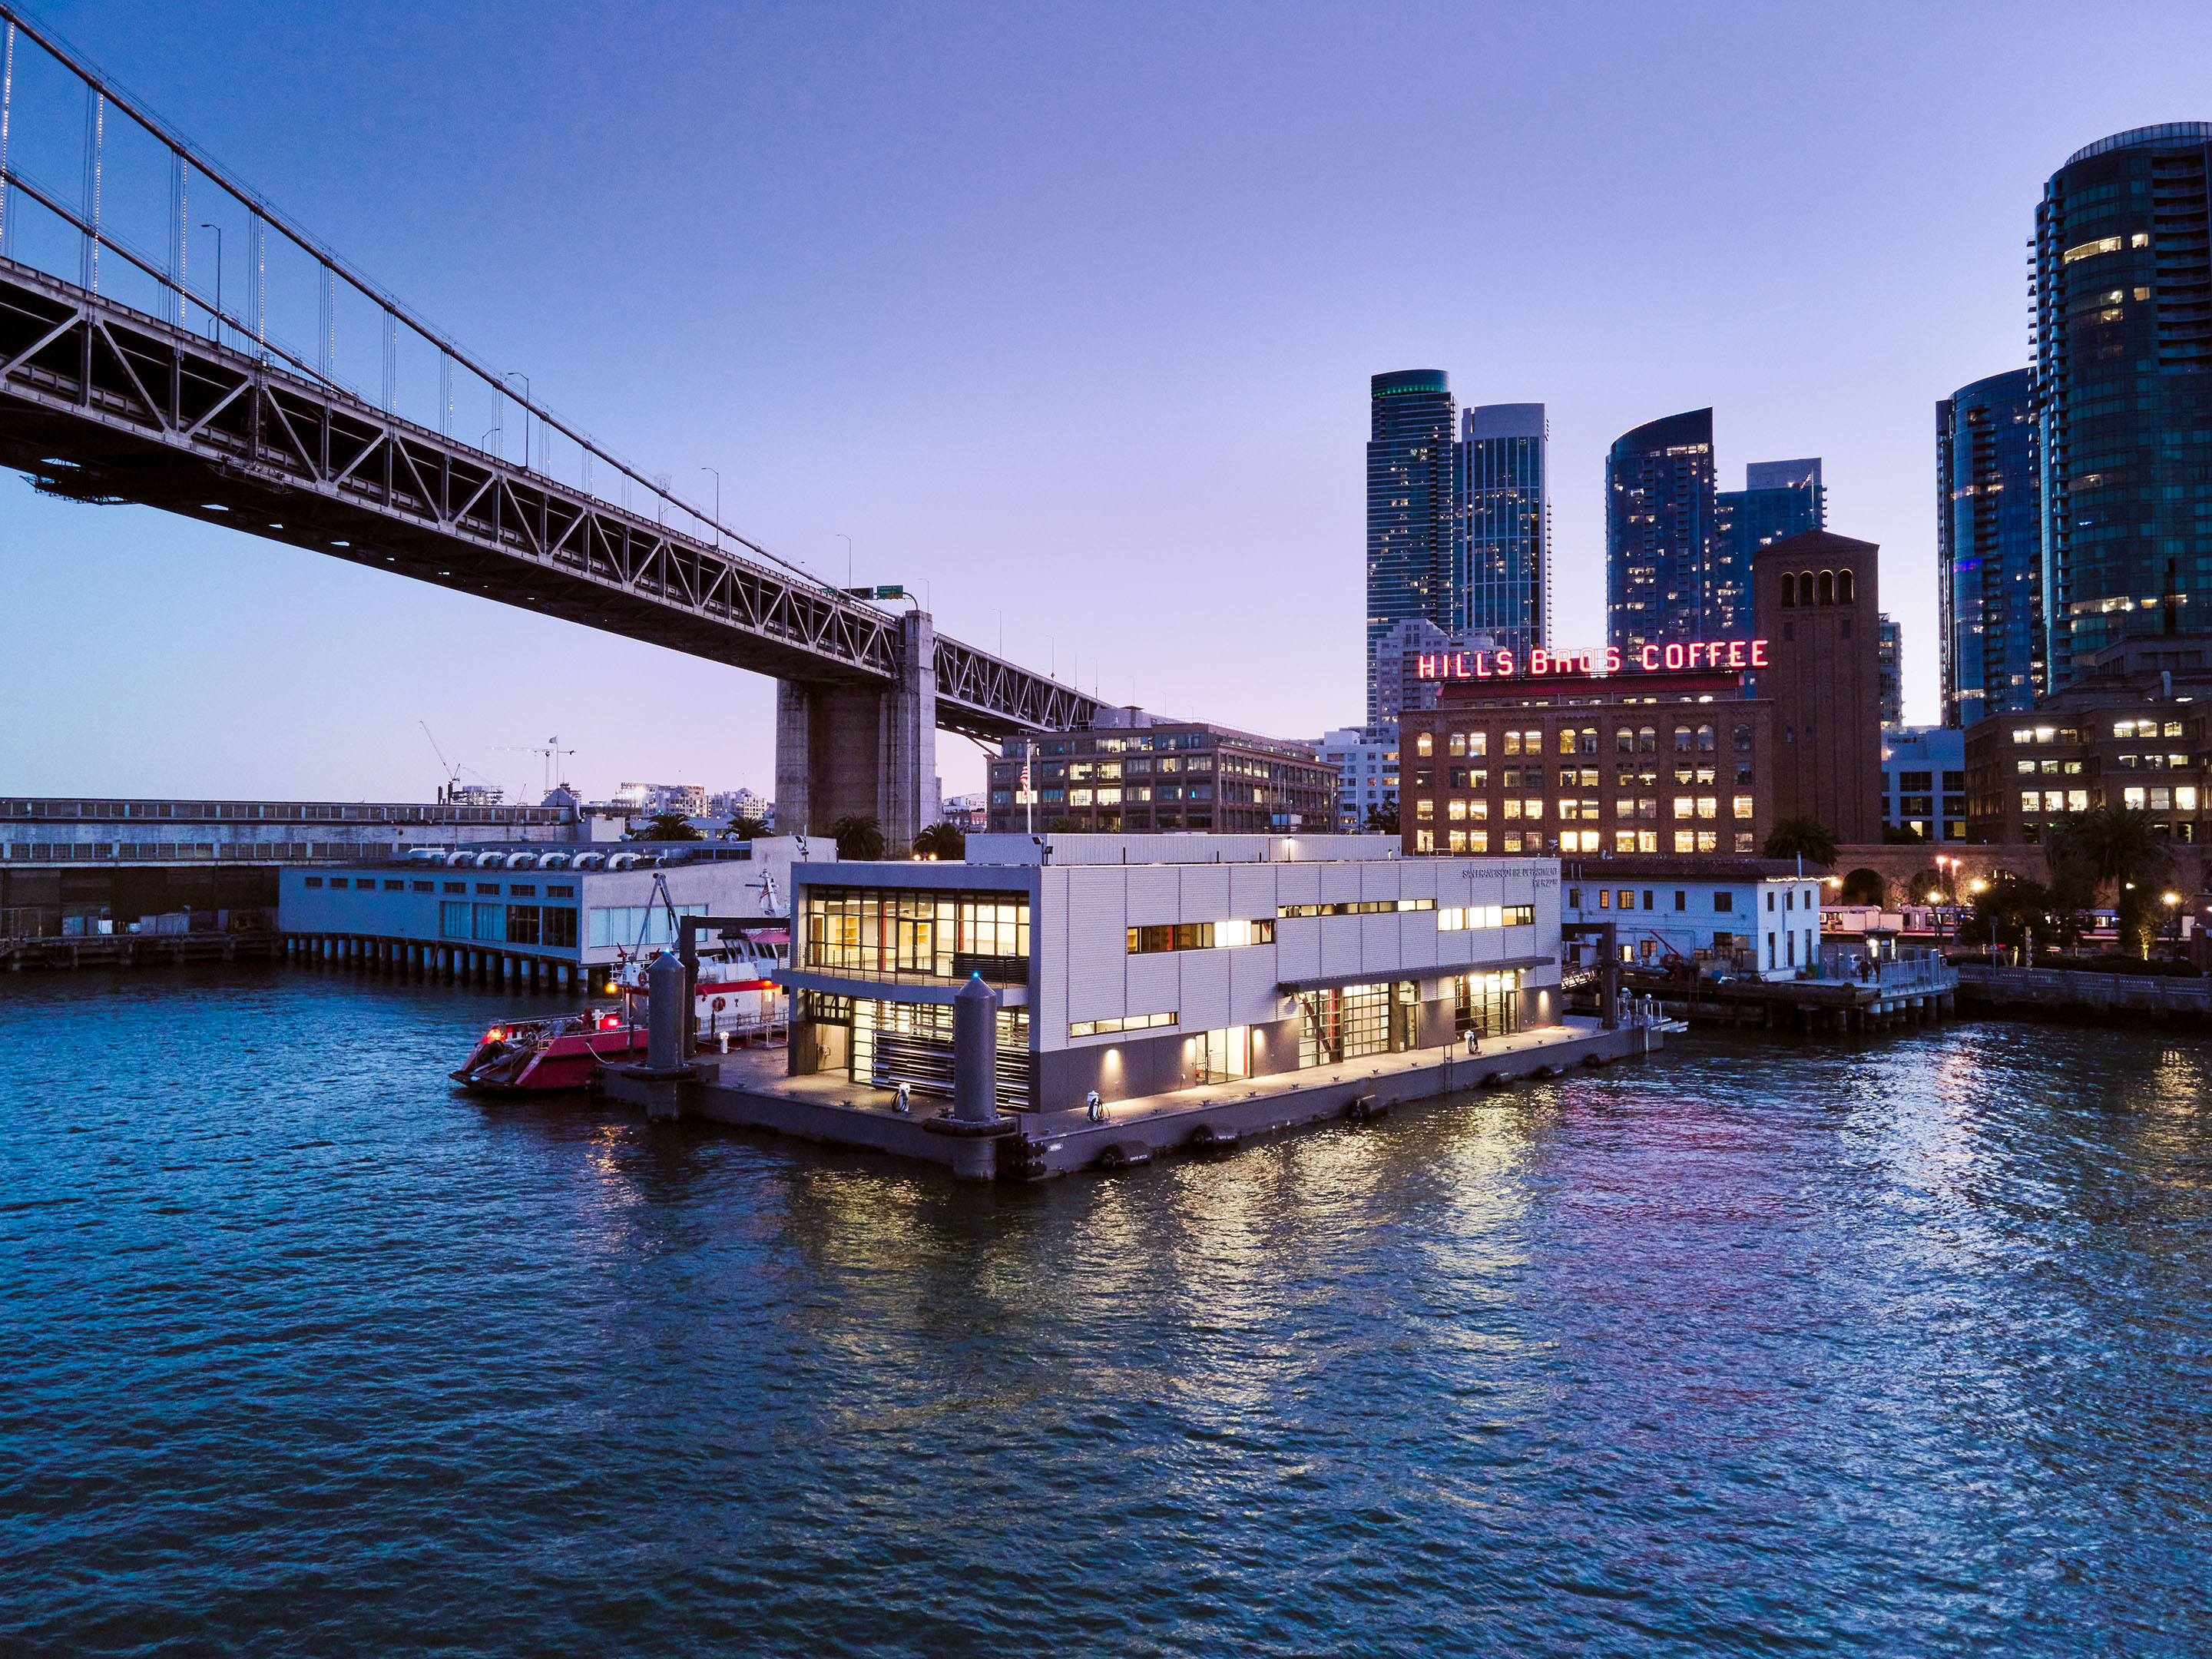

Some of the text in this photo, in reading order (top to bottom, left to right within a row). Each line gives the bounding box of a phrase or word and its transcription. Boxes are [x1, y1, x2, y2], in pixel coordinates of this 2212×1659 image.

[1419, 640, 1769, 678] HILLS BROS COFFEE
[1462, 869, 1475, 879] SAN
[1475, 868, 1509, 878] FRANCISCO
